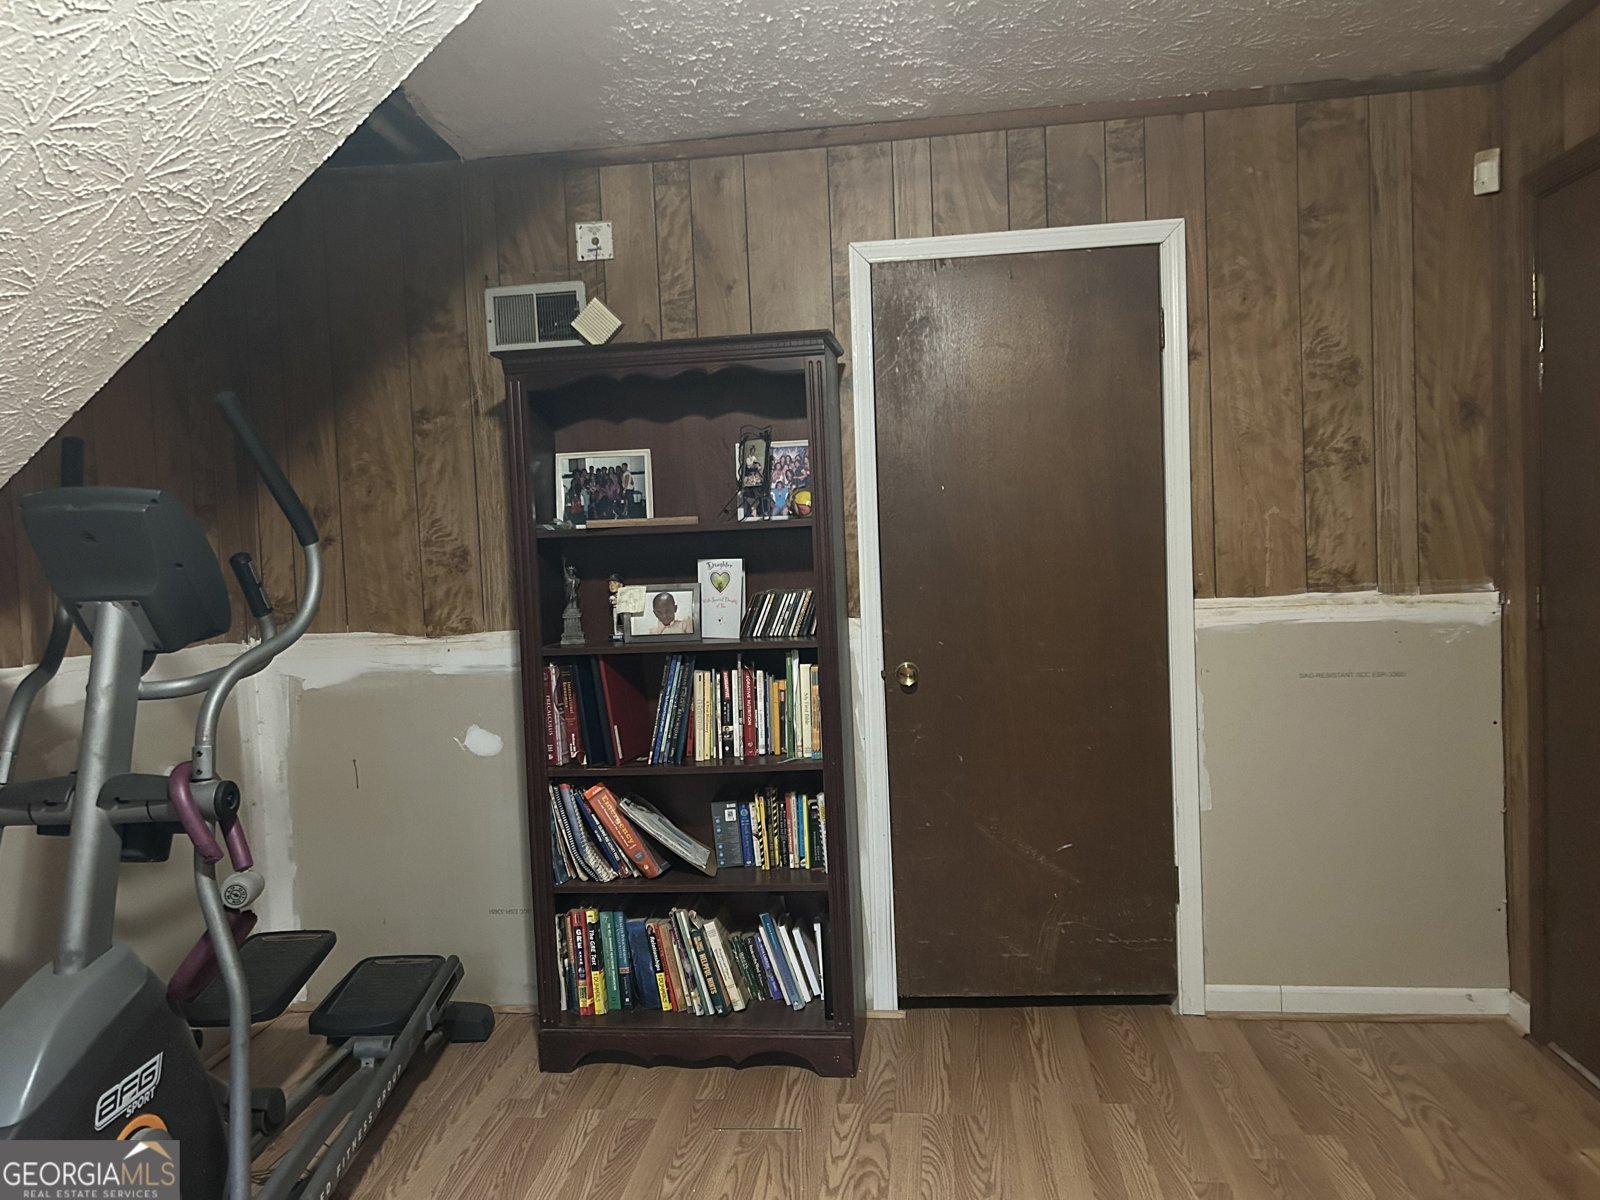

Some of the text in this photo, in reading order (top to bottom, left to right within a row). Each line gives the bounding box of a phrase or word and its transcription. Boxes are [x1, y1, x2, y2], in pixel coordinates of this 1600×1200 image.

[602, 794, 634, 845] Emergency
[650, 936, 660, 971] Relationships
[700, 953, 717, 994] HELPFUL HINTS
[126, 1086, 156, 1118] SPORT
[336, 1111, 373, 1178] FITNESS
[376, 1064, 402, 1109] GROUP
